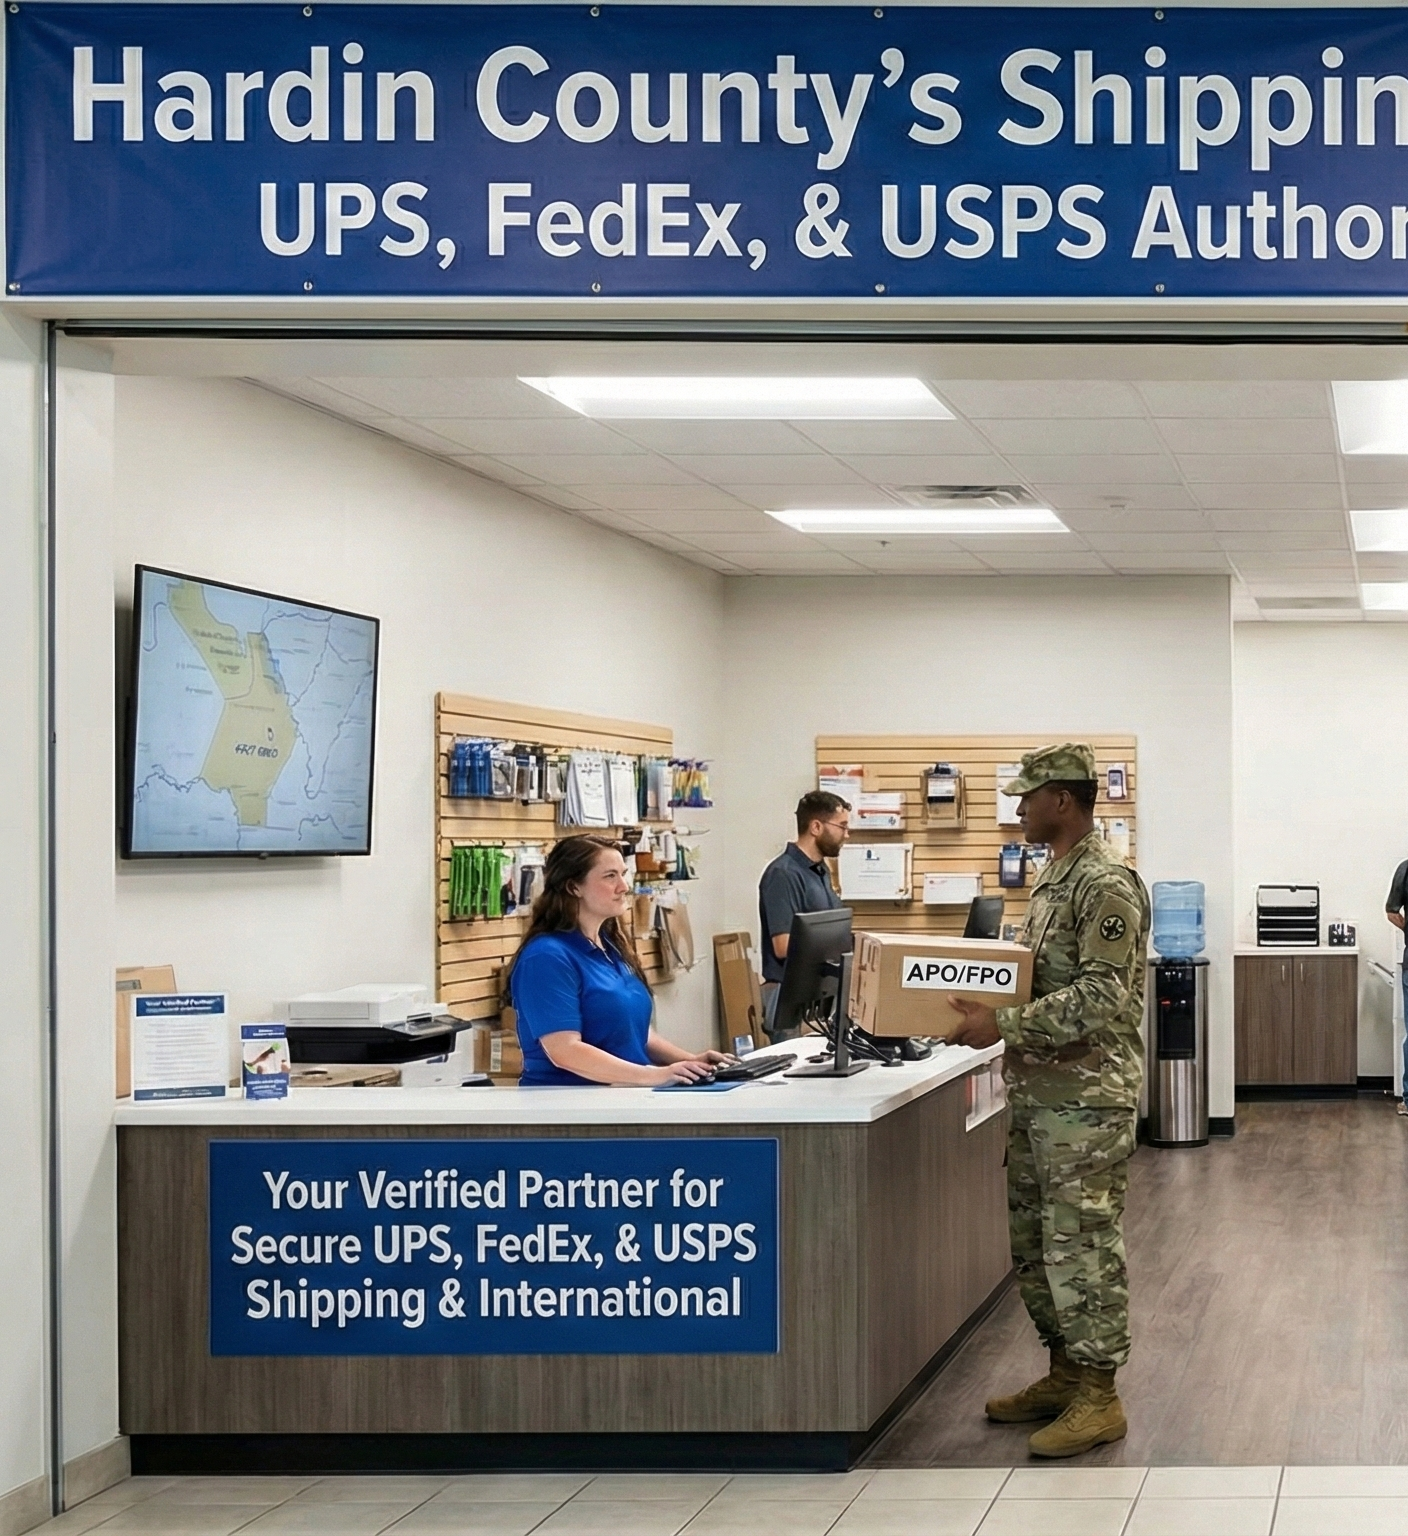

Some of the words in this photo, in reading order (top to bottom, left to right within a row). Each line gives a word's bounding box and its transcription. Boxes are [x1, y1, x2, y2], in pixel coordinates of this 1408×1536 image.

[74, 44, 435, 143] Hardin
[478, 47, 962, 170] County’s
[262, 183, 456, 270] UPS,
[490, 184, 767, 270] FedEx,
[797, 184, 852, 259] &
[883, 185, 1107, 260] USPS
[906, 963, 1012, 986] APO/FPO
[264, 1172, 350, 1210] Your
[360, 1169, 507, 1210] Verified
[520, 1171, 661, 1210] Partner
[670, 1168, 725, 1209] for
[232, 1226, 363, 1266] Secure
[375, 1225, 463, 1271] UPS,
[478, 1225, 605, 1270] FedEx,
[616, 1224, 643, 1263] &
[655, 1223, 758, 1262] USPS
[247, 1278, 426, 1329] Shipping
[439, 1278, 467, 1319] &
[481, 1276, 742, 1319] International
